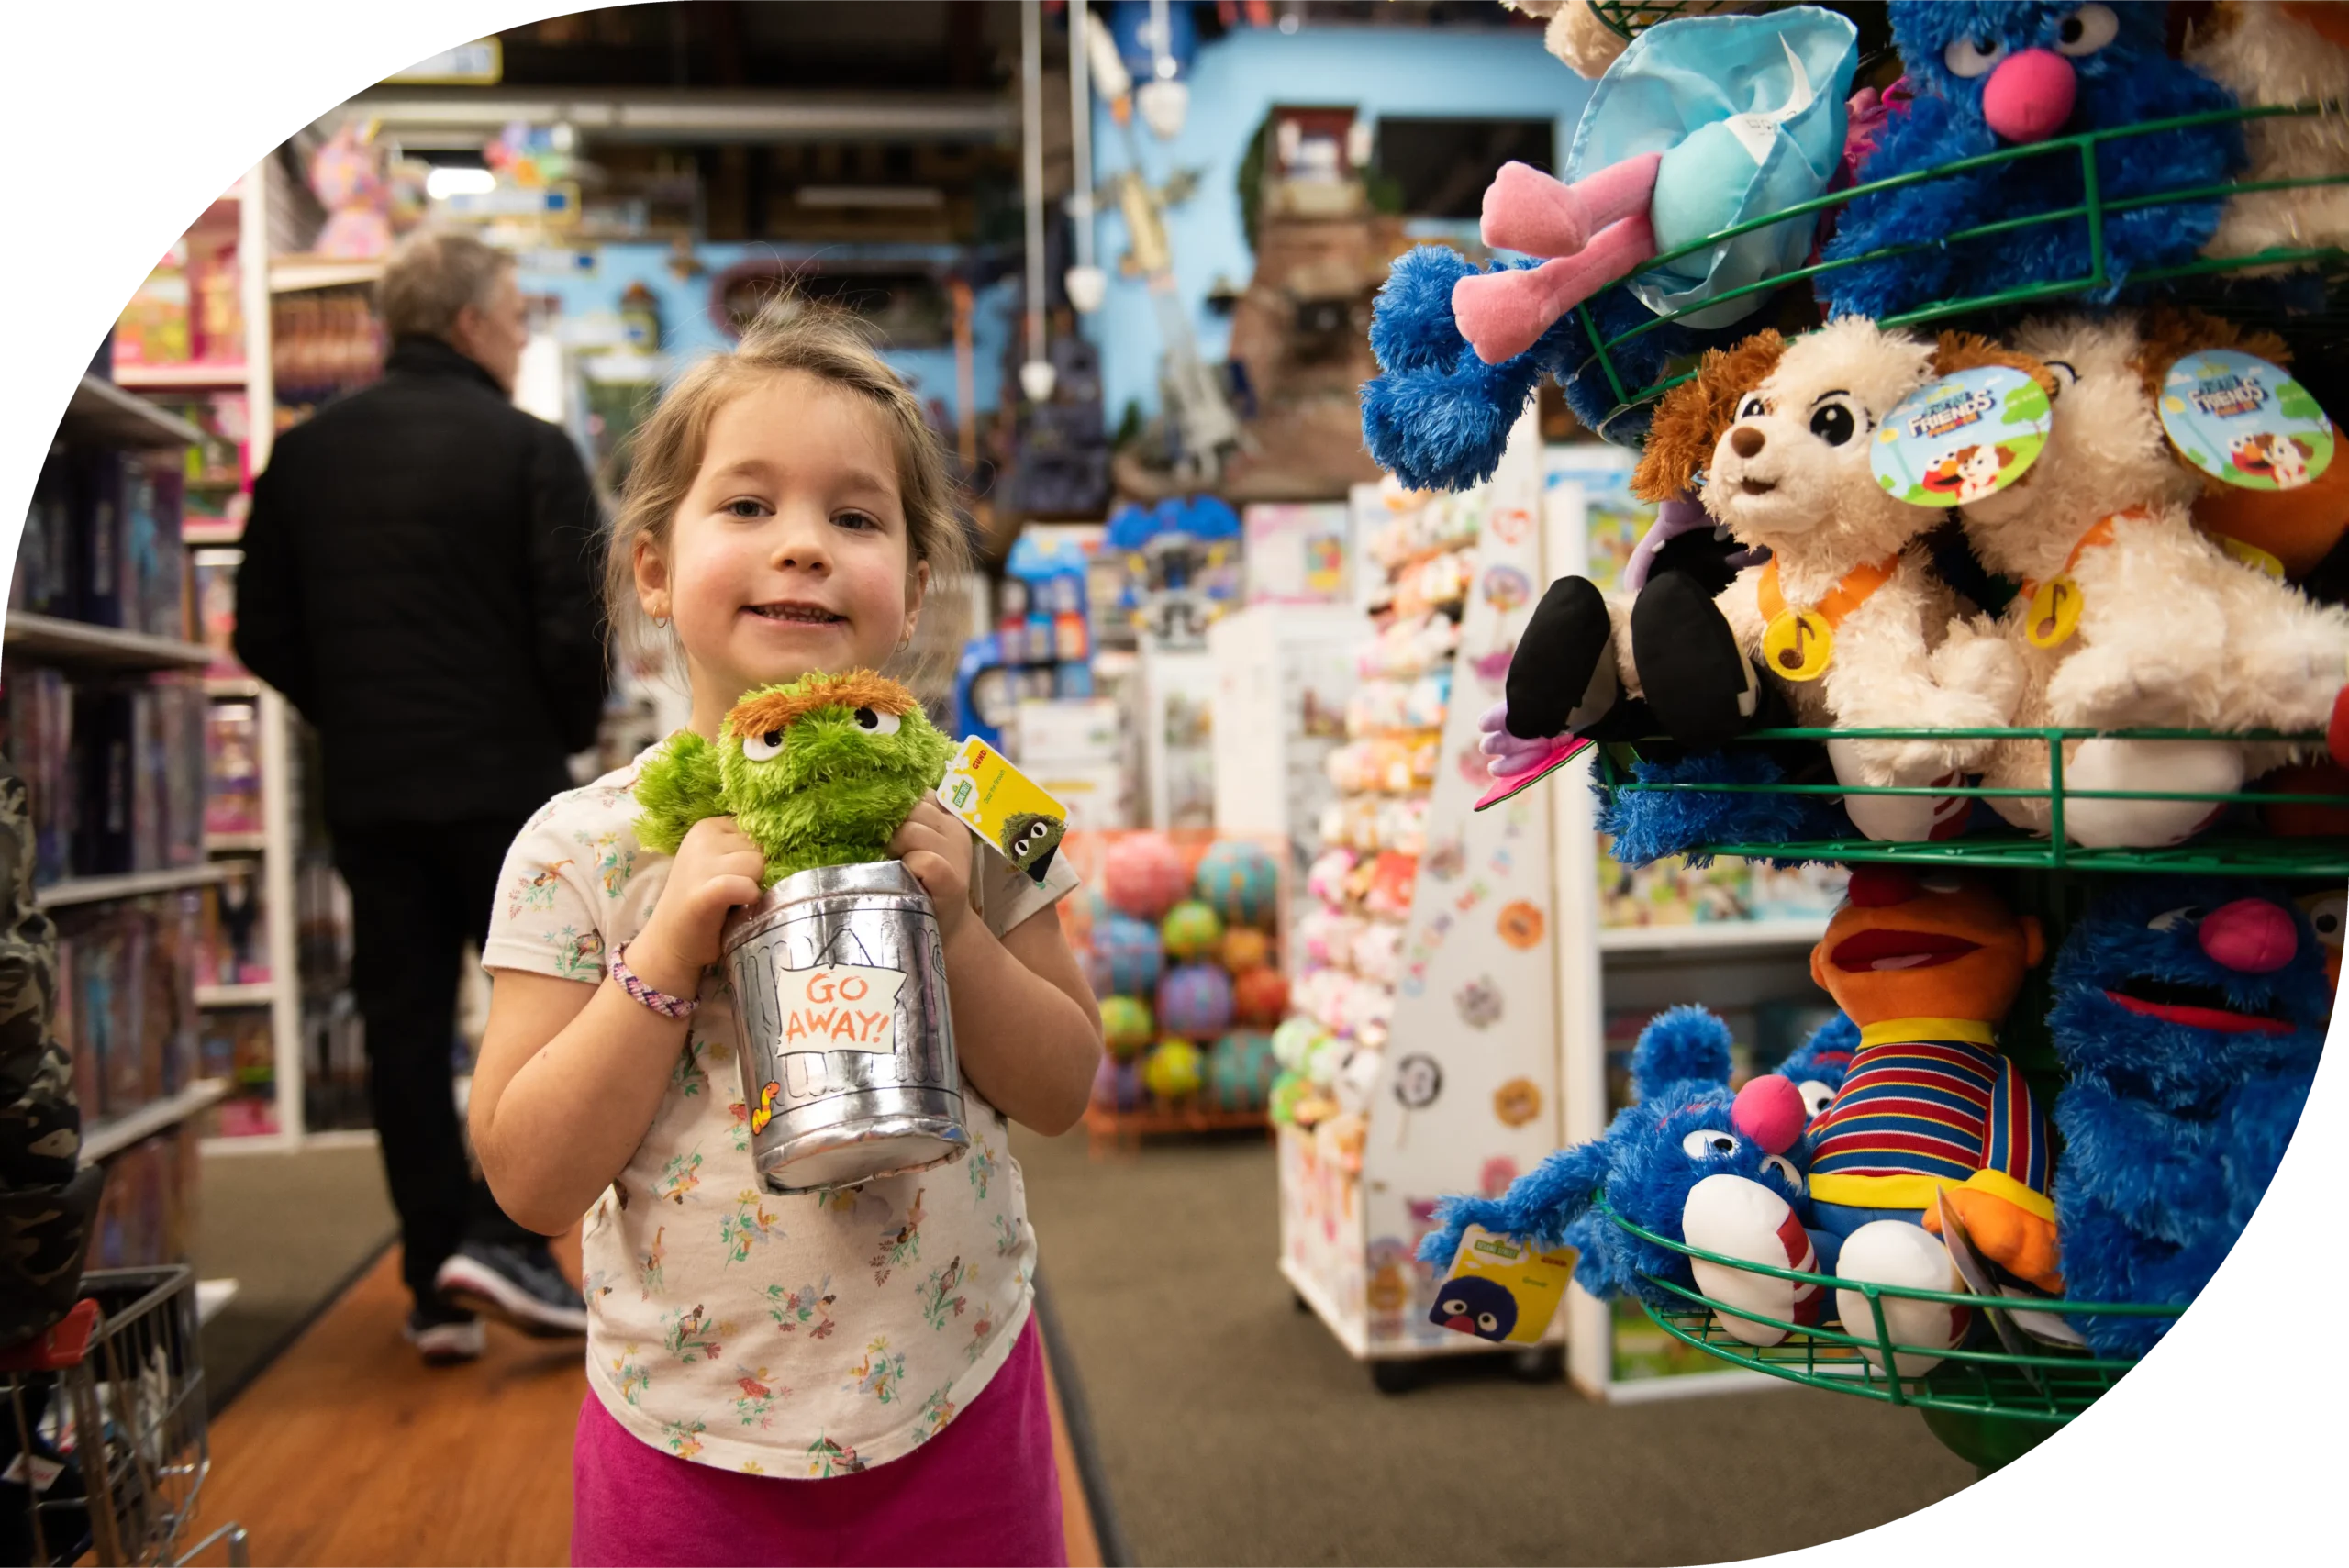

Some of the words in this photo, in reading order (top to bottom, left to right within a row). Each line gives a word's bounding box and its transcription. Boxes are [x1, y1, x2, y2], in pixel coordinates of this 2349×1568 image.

[2188, 378, 2265, 413] FRIENDS
[1908, 390, 1992, 438] FRIENDS
[973, 749, 987, 770] GUND
[994, 769, 1006, 784] Grouch
[806, 972, 869, 1004] GO
[785, 1006, 890, 1044] AWAY!
[1476, 1241, 1497, 1254] SESAME
[1497, 1246, 1519, 1259] STREET
